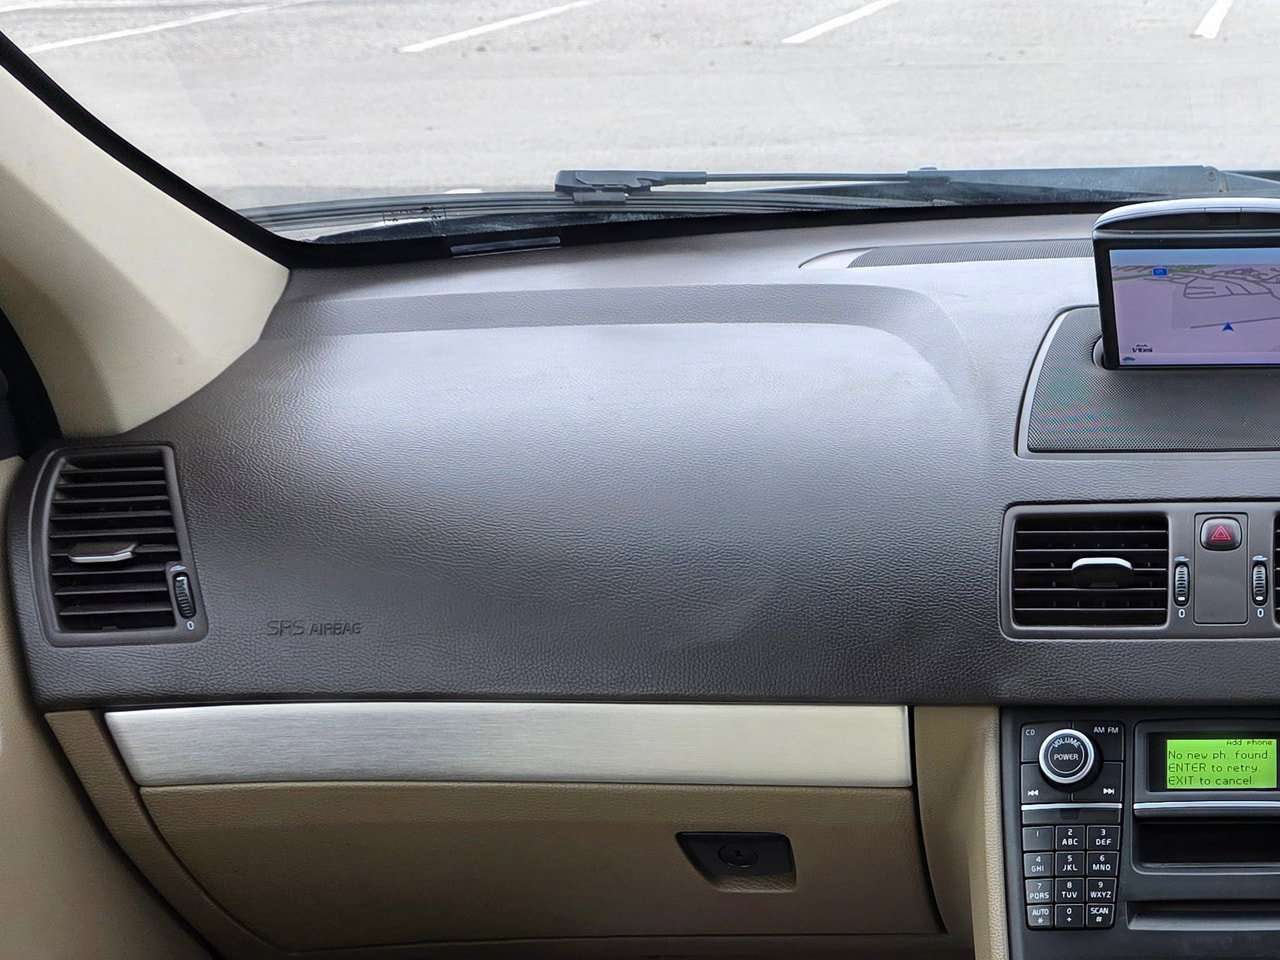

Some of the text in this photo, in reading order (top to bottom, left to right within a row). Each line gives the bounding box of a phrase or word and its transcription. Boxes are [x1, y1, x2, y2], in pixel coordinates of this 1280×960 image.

[309, 622, 363, 636] AIRBAG
[1093, 726, 1105, 734] AM
[1052, 736, 1081, 749] VOLUME
[1053, 753, 1079, 761] POWER
[1168, 751, 1183, 760] No
[1187, 752, 1208, 760] new
[1168, 763, 1207, 773] ENTER
[1211, 764, 1223, 773] to
[1168, 776, 1194, 786] EXIT
[1199, 777, 1211, 786] to
[1067, 828, 1073, 836] 2
[1100, 828, 1106, 836] 3
[1061, 838, 1079, 846] ABC
[1095, 838, 1112, 846] DEF
[1035, 855, 1041, 863] 4
[1067, 854, 1073, 862] 5
[1099, 854, 1105, 862] 6
[1031, 865, 1045, 873] GHI
[1062, 864, 1078, 872] JKL
[1092, 863, 1111, 871] MNO
[1036, 882, 1042, 890] 7
[1066, 881, 1072, 889] 8
[1098, 881, 1104, 889] 9
[1061, 891, 1078, 899] TUV
[1090, 891, 1112, 899] WXYZ
[1031, 908, 1049, 916] AUTO
[1066, 907, 1072, 915] 0
[1090, 907, 1109, 915] SCAN
